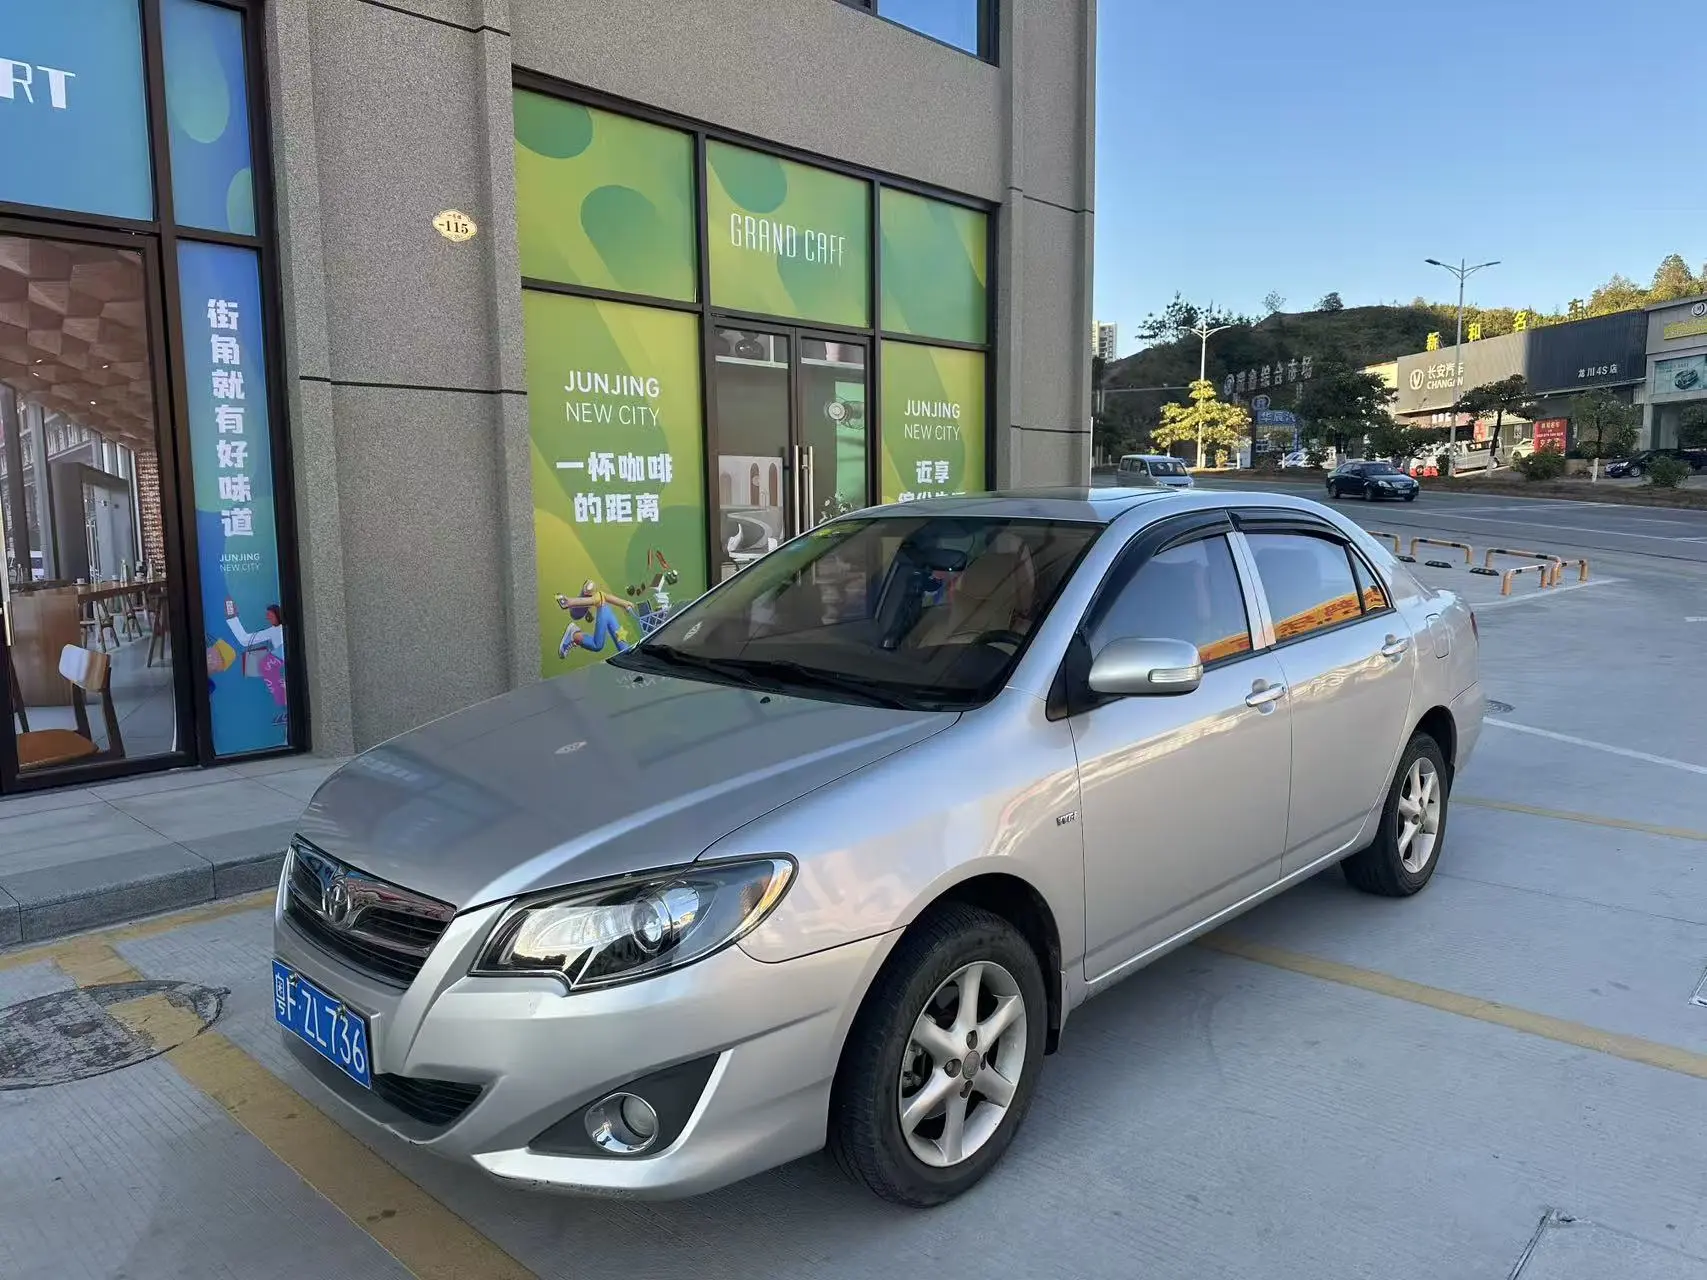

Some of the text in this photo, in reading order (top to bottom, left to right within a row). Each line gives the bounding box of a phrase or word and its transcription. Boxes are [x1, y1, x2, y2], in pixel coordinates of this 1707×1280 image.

[730, 213, 846, 267] GRAND CAFF
[564, 370, 661, 398] JUNJING
[207, 299, 254, 537] 街角就有好味道
[566, 402, 660, 426] NEW CITY
[904, 399, 960, 419] JUNJING
[904, 424, 960, 441] NEW CITY
[556, 452, 673, 483] 一杯咖啡
[916, 460, 950, 484] 近享
[574, 492, 660, 524] 的距离
[219, 553, 261, 562] JUNJING
[219, 563, 262, 573] NEW CITY
